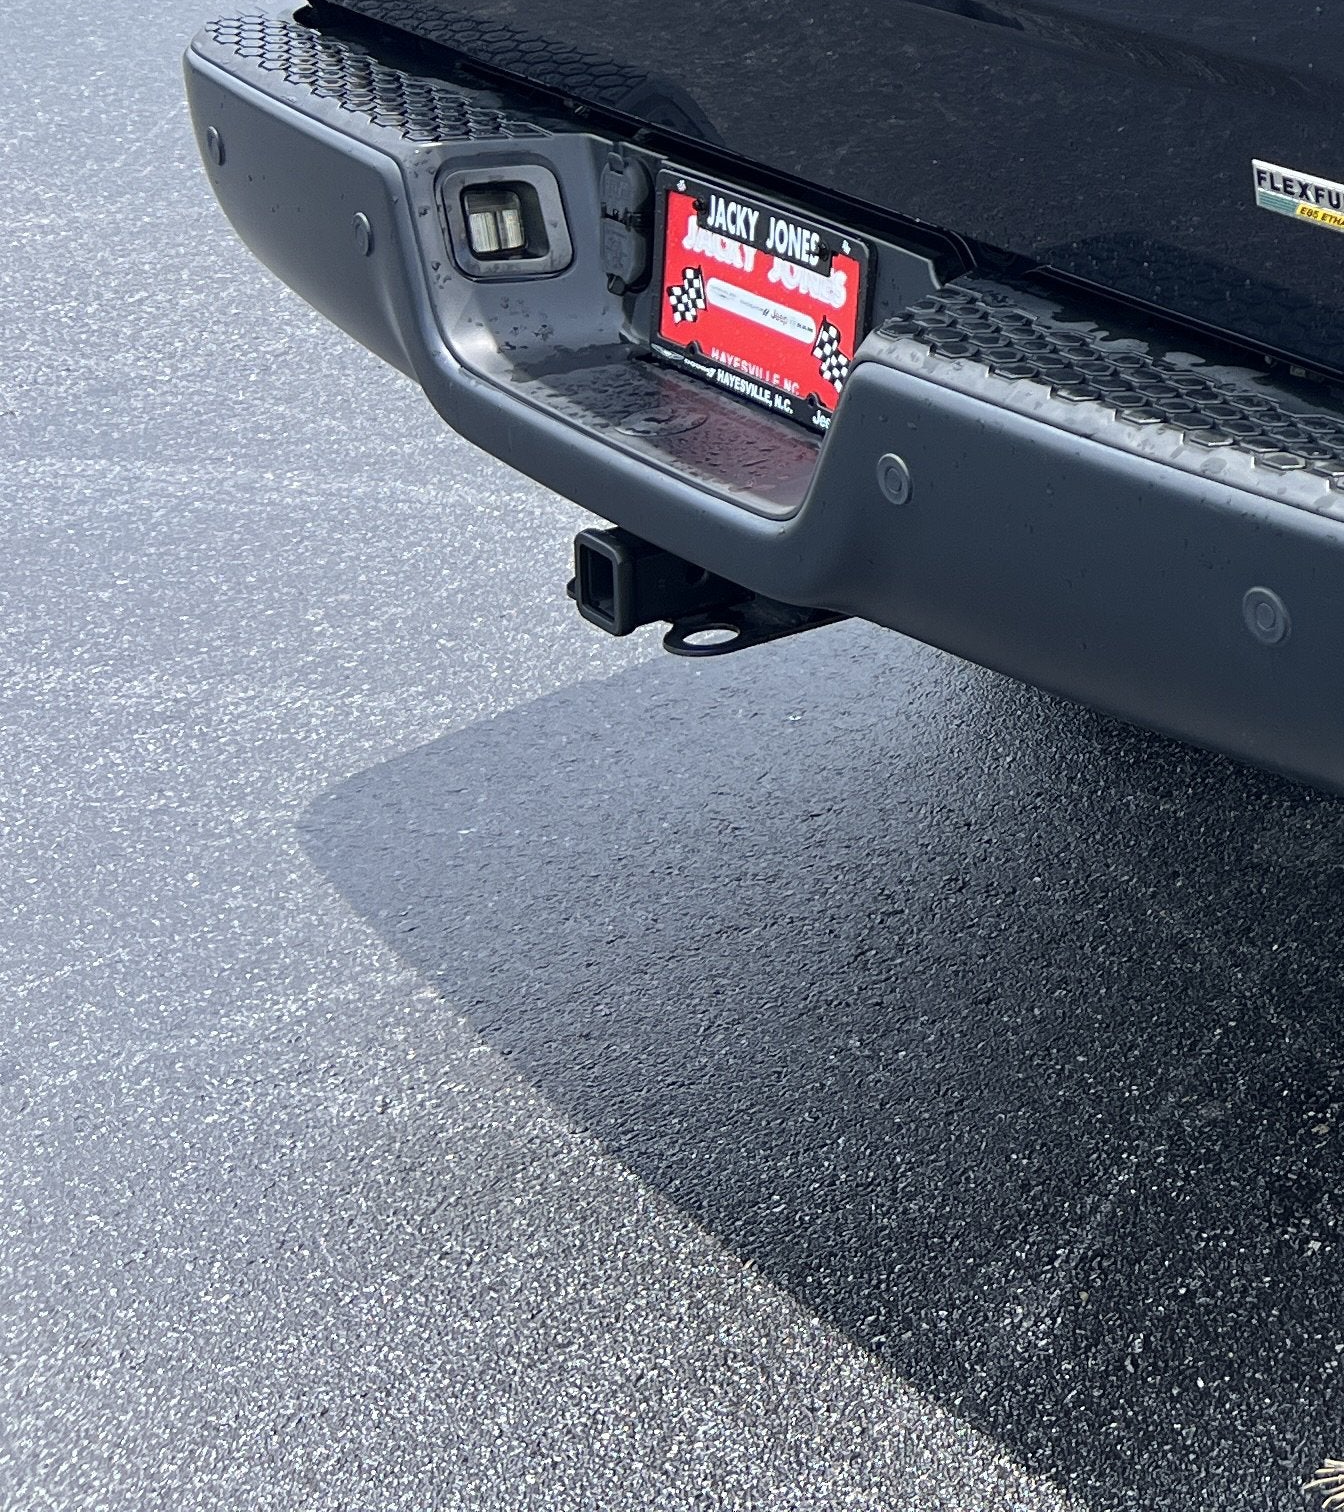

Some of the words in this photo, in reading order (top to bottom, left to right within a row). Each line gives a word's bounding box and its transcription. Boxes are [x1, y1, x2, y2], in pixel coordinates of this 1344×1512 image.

[1300, 207, 1319, 220] E85
[707, 194, 759, 242] JACKY
[766, 216, 820, 266] JONES
[711, 347, 780, 385] HAYESVILLE
[773, 393, 794, 415] N.C.
